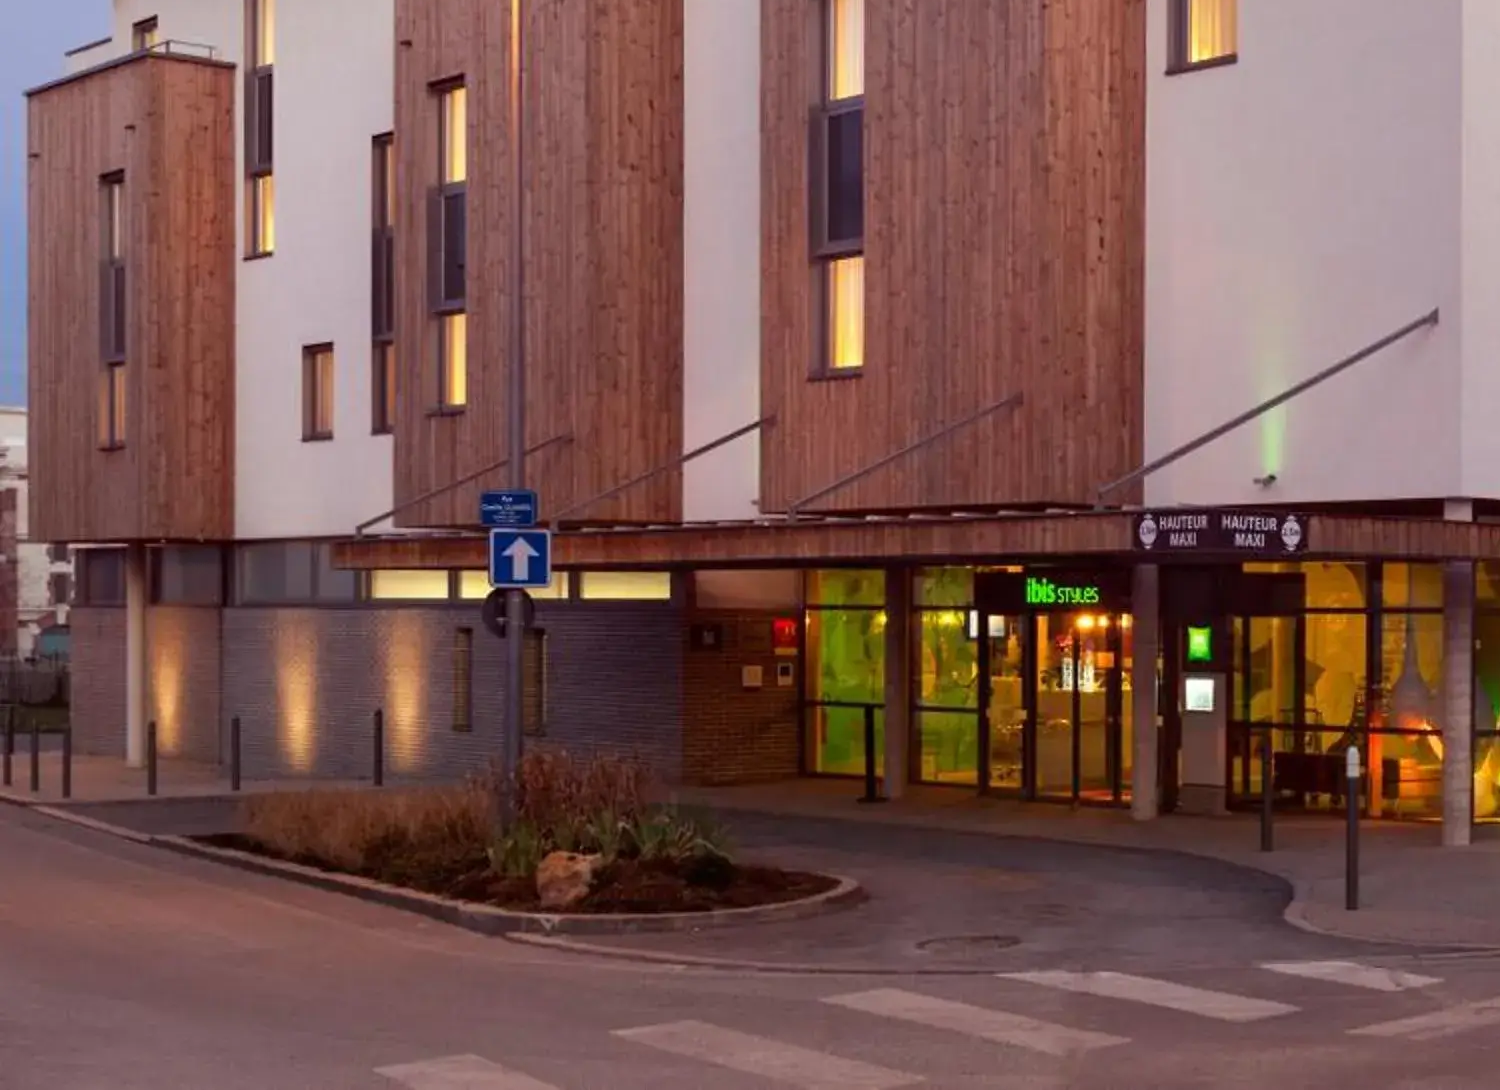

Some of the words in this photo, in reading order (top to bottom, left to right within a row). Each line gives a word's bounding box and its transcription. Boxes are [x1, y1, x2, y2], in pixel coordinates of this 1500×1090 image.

[1159, 515, 1209, 531] HAUTEUR
[1221, 514, 1278, 532] HAUTEUR
[1169, 532, 1198, 548] MAXI
[1234, 532, 1266, 548] MAXI
[1026, 576, 1056, 604] ibis
